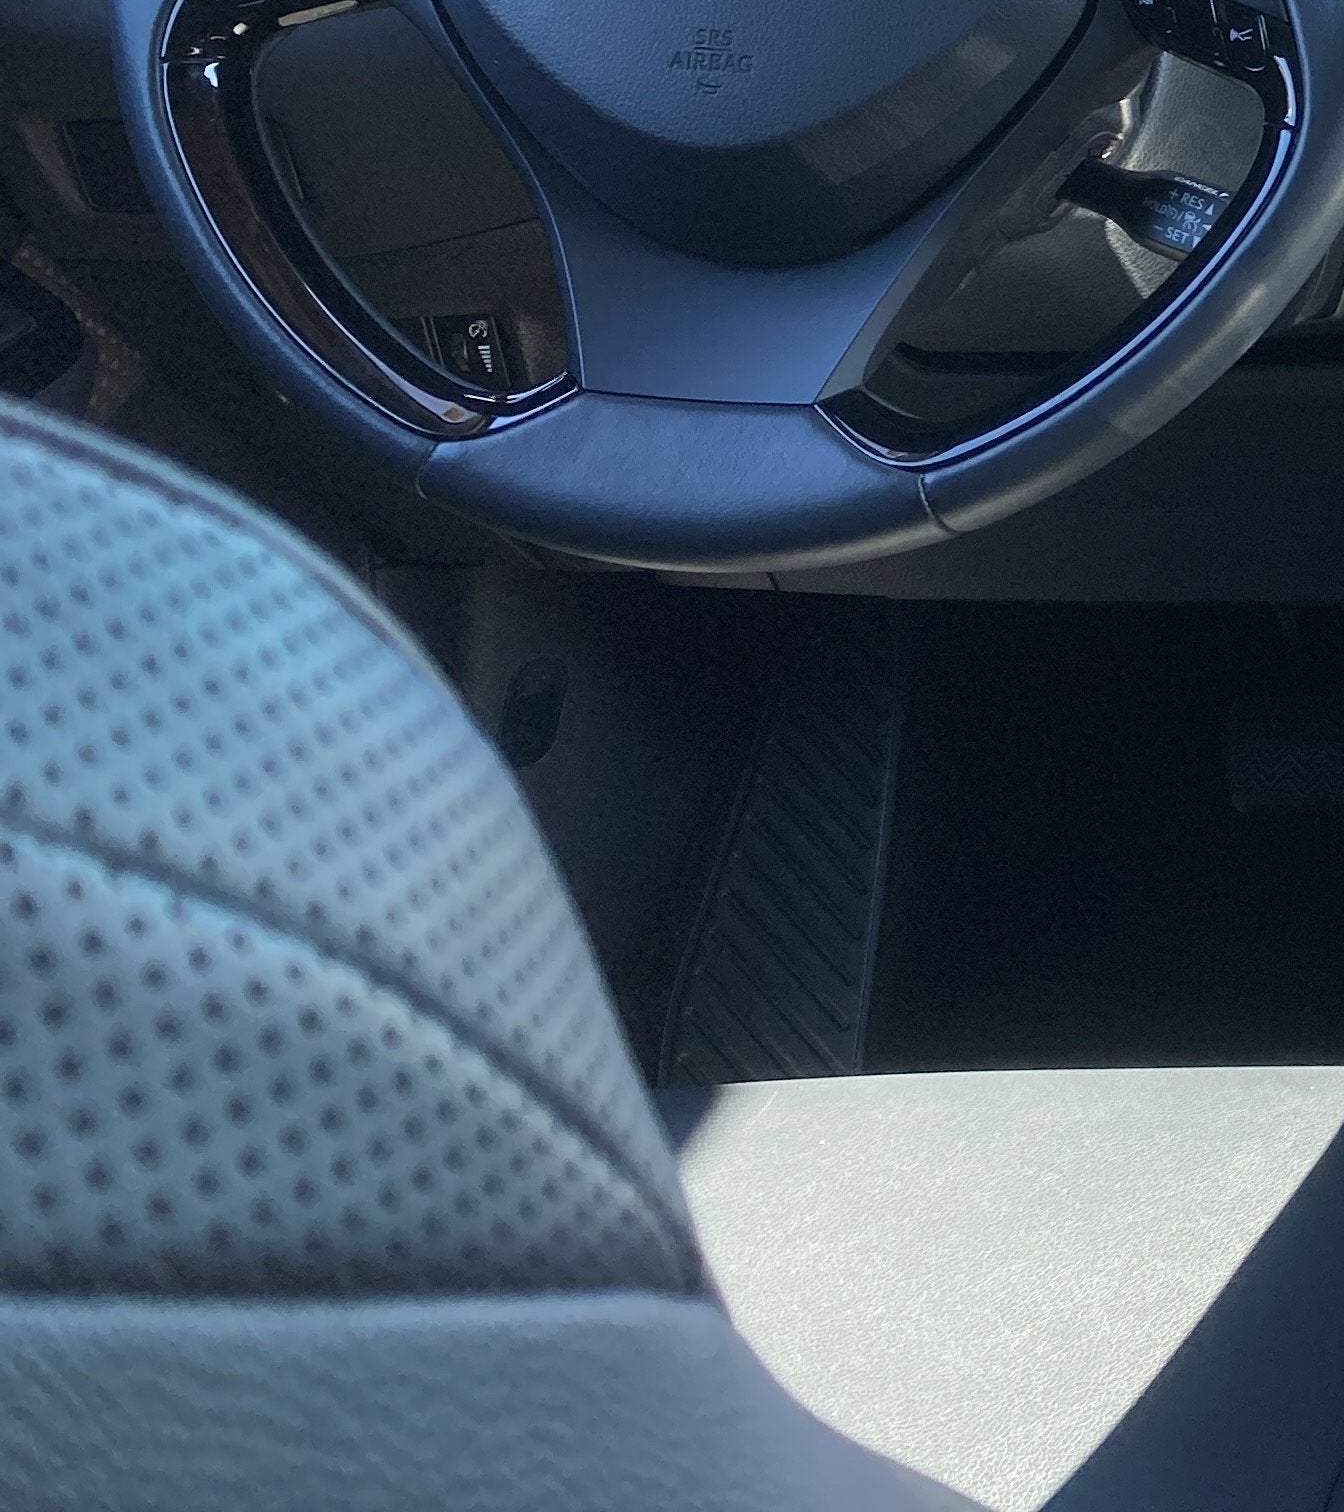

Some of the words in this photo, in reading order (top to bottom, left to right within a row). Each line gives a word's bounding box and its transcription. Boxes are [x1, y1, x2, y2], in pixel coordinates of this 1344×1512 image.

[694, 28, 734, 46] SRS
[669, 50, 755, 73] AIRBAG
[1180, 192, 1206, 210] RES
[1164, 226, 1190, 245] SET
